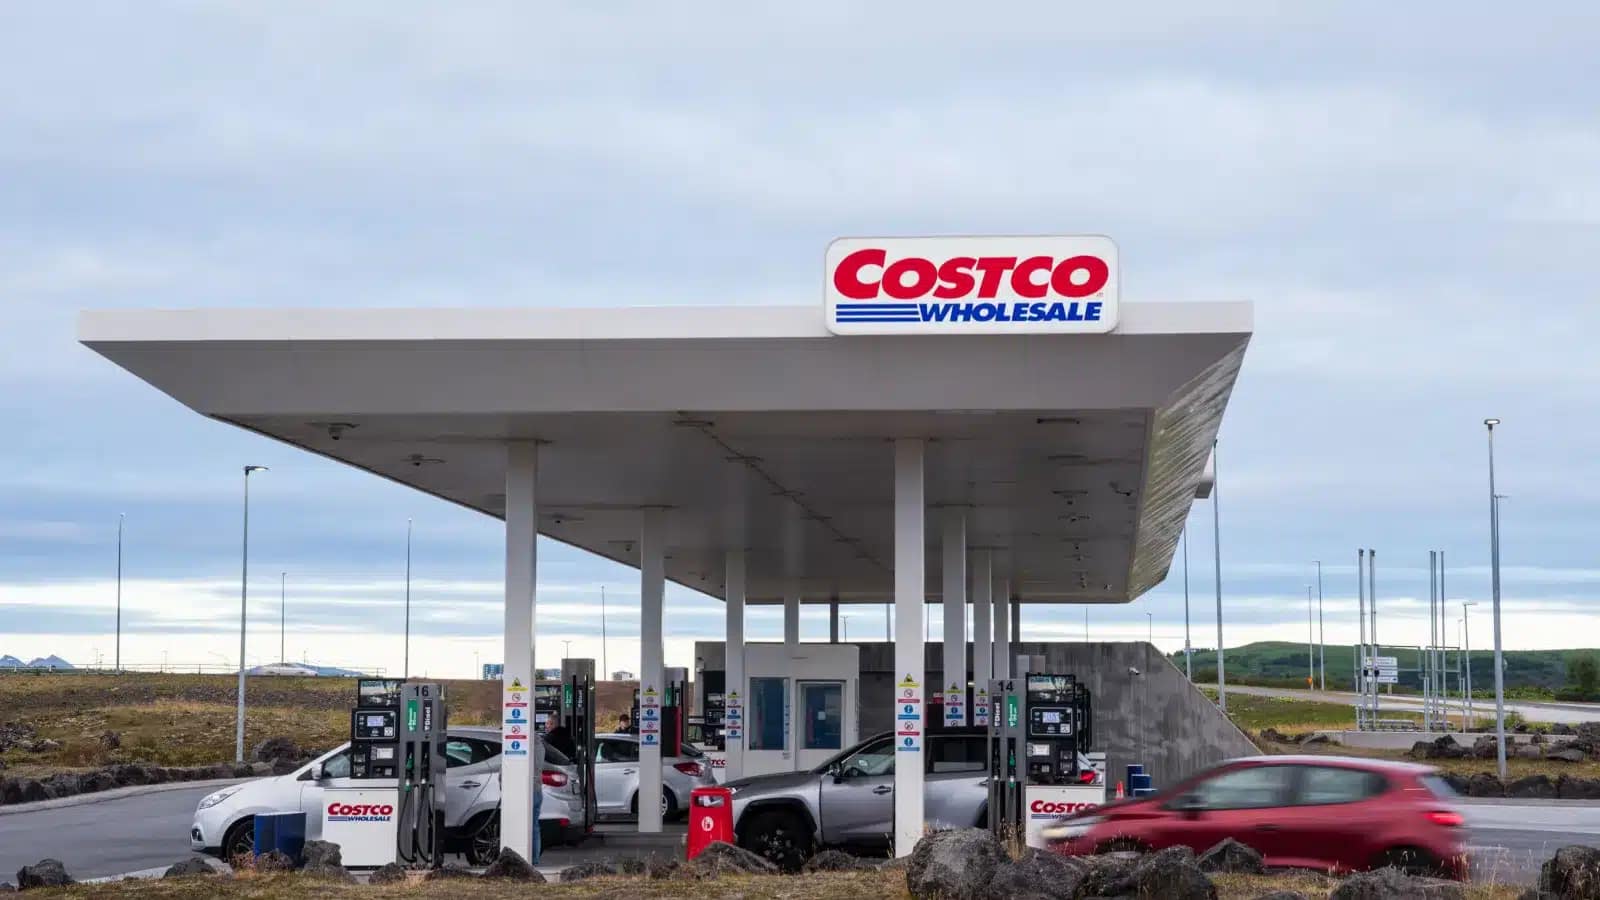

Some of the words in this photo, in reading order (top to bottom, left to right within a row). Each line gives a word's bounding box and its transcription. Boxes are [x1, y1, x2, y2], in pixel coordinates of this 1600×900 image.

[834, 249, 1109, 299] COSTCO
[919, 302, 1103, 322] WHOLESALE
[415, 686, 428, 697] 16
[998, 681, 1014, 692] 14
[328, 803, 393, 815] COSTCO
